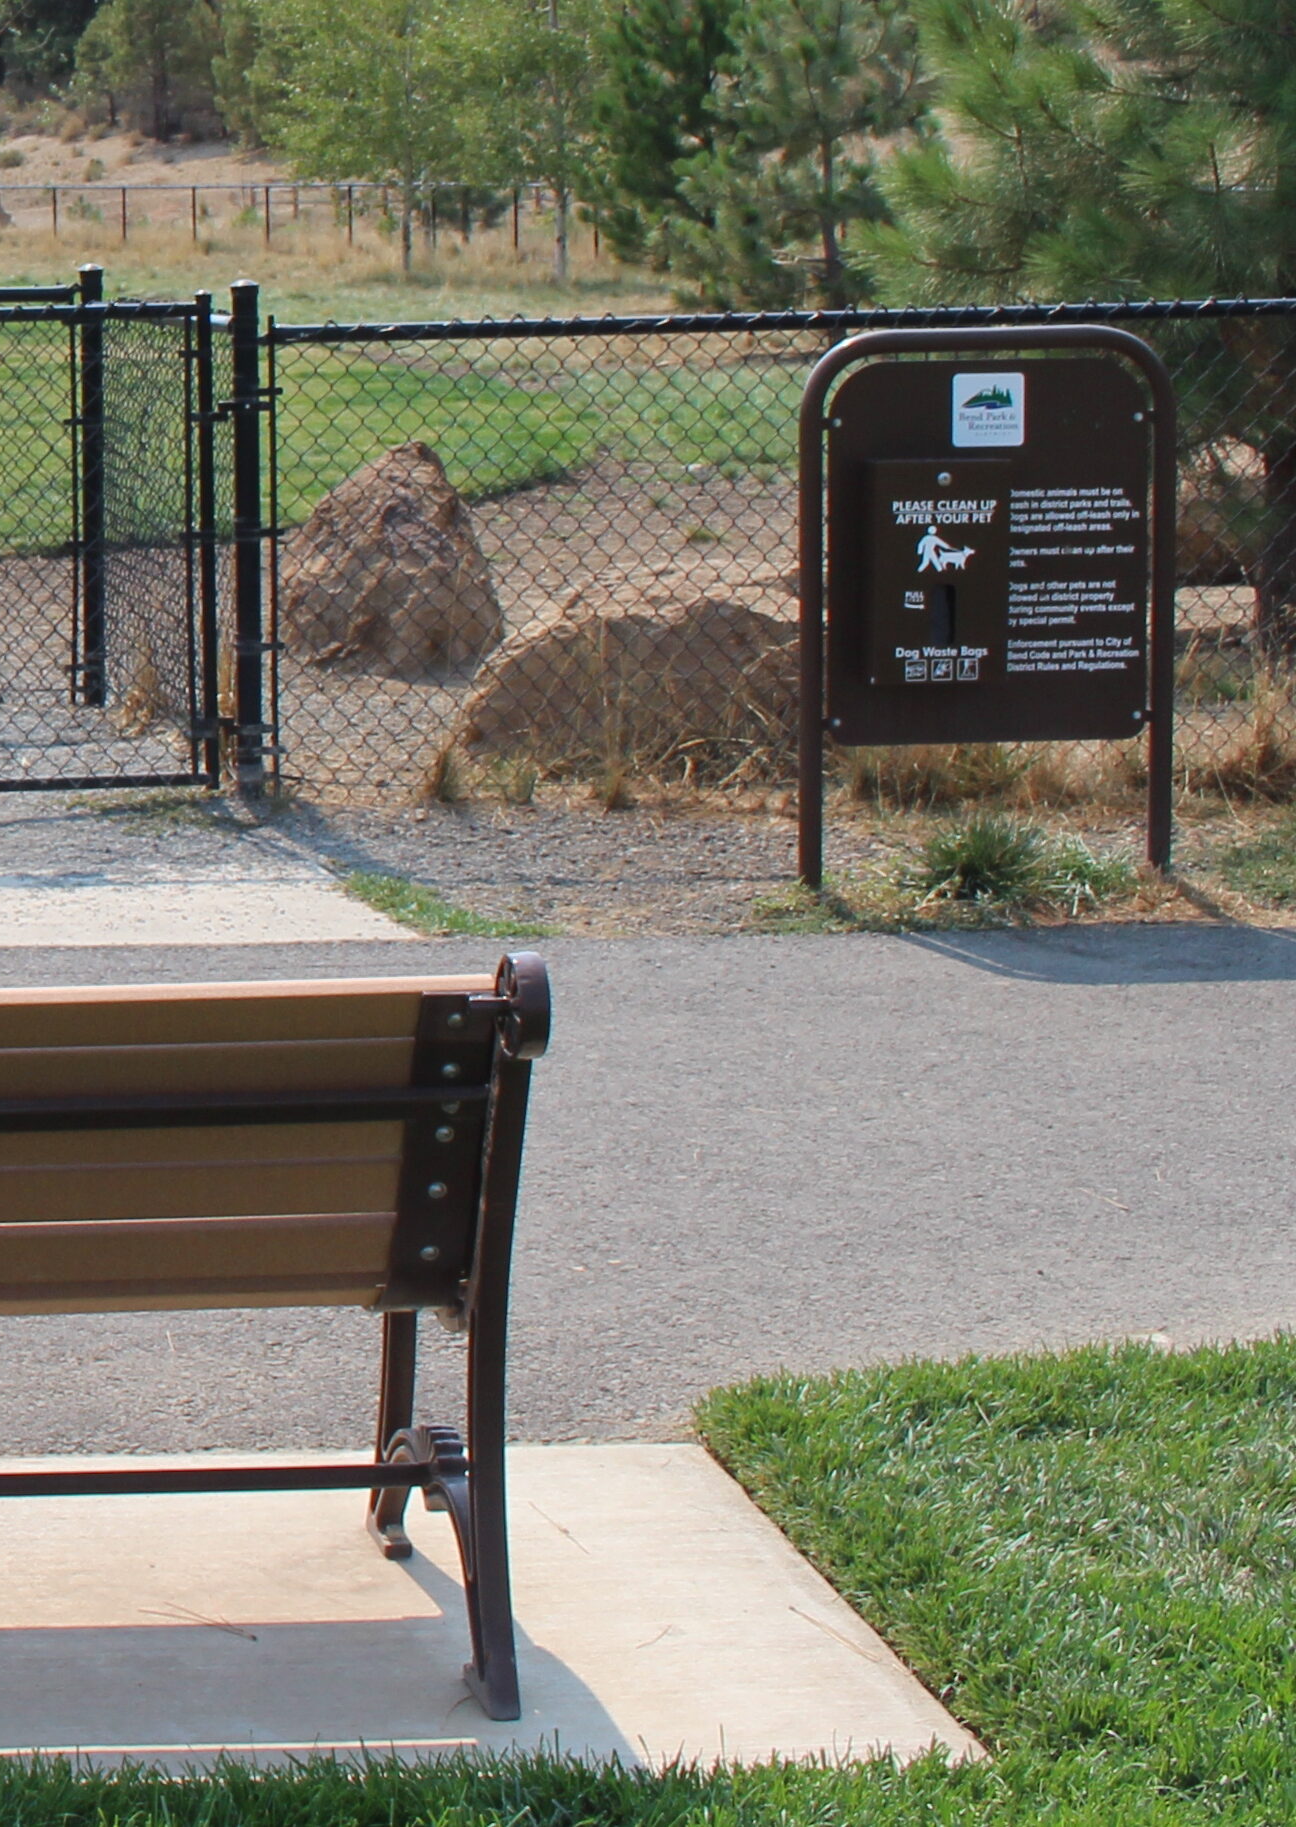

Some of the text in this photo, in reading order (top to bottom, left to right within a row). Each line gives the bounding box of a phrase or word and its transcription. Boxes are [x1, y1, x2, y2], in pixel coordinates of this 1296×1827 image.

[986, 412, 1005, 420] Park
[969, 422, 1018, 430] Recreation
[1047, 489, 1077, 497] animals
[1079, 488, 1099, 496] must
[1100, 487, 1110, 495] be
[893, 500, 997, 511] PLEASE CLEAN UP
[1031, 500, 1039, 509] in
[1040, 499, 1068, 508] district
[1069, 500, 1091, 510] parks
[896, 513, 992, 524] AFTER YOUR PET
[1045, 511, 1075, 520] allowed
[1076, 511, 1111, 520] off-leash
[1112, 511, 1130, 520] only
[1132, 510, 1140, 518] in
[1053, 523, 1087, 532] off-leash
[1039, 547, 1060, 555] must
[1096, 545, 1114, 554] after
[1115, 544, 1135, 553] their
[1030, 582, 1045, 590] and
[1047, 581, 1067, 590] other
[1069, 582, 1086, 590] pets
[1102, 580, 1116, 589] not
[1051, 592, 1079, 601] district
[1080, 592, 1114, 601] property
[1035, 605, 1078, 614] community
[1108, 603, 1135, 613] except
[1019, 616, 1047, 626] special
[1008, 637, 1132, 648] Enforcement pursuant to City of
[896, 646, 988, 660] Dog Waste Bags
[1007, 649, 1139, 660] Bend Code and Park & Recreation
[1007, 663, 1035, 671] District
[1037, 662, 1059, 671] Rules
[1061, 661, 1076, 670] and
